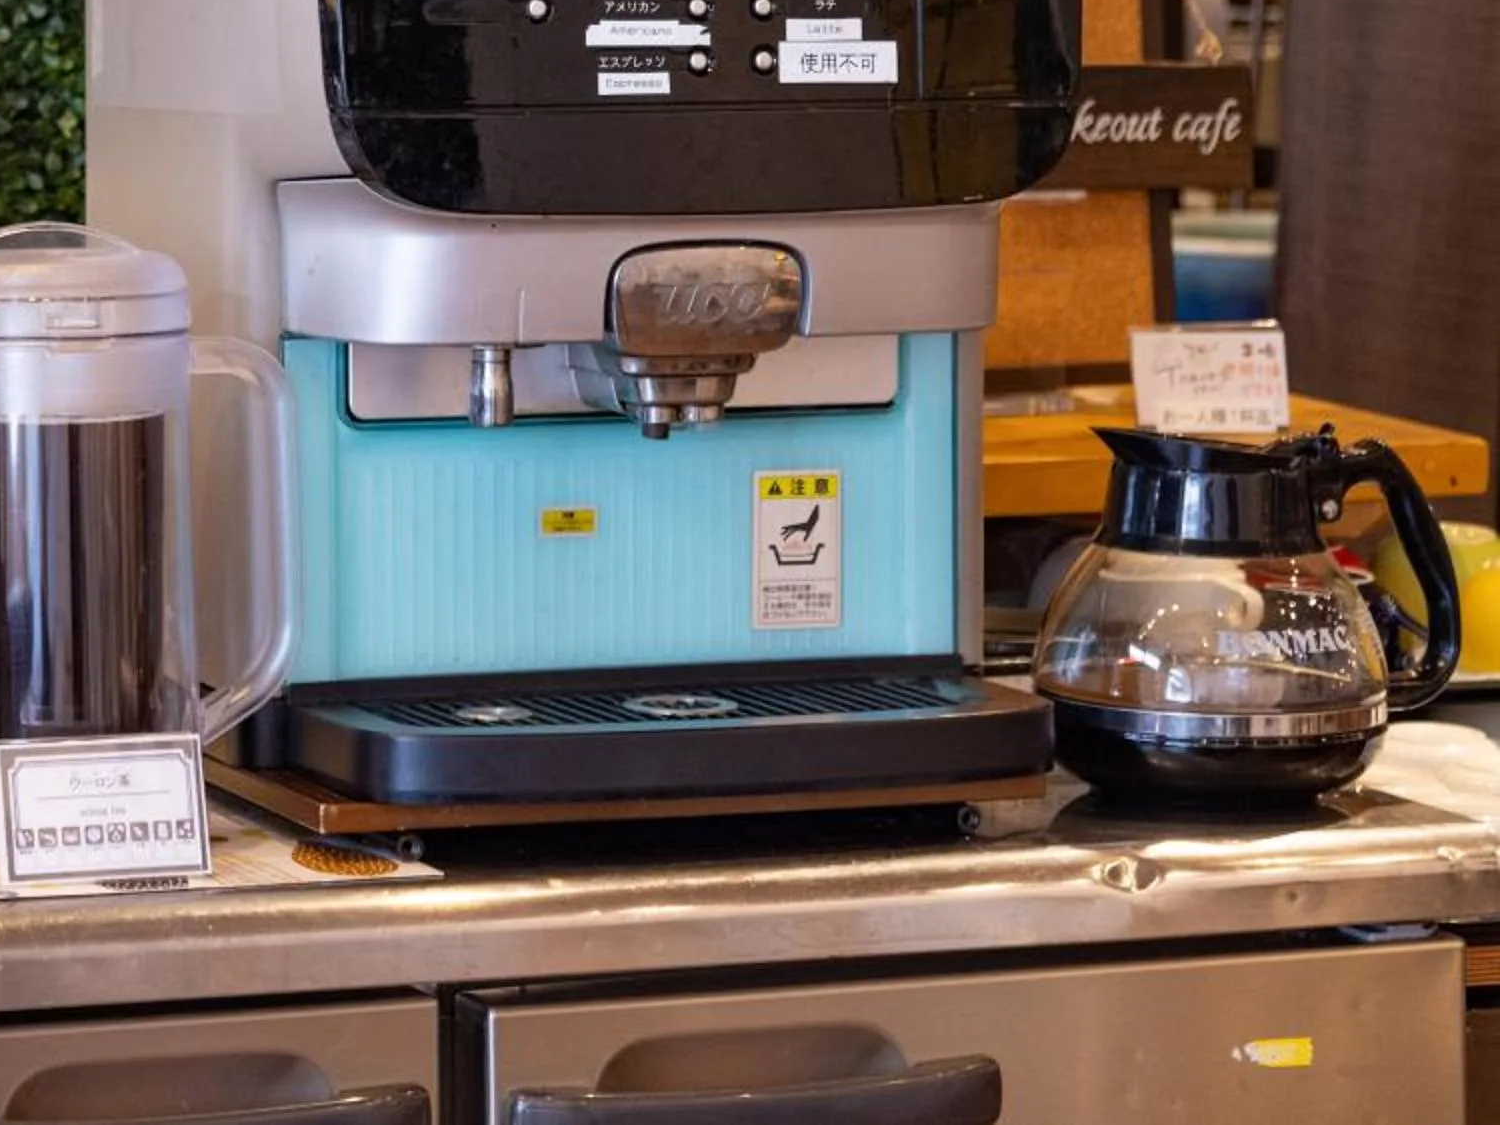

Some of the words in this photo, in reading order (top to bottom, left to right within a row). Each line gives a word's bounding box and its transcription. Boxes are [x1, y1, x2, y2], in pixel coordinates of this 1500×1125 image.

[604, 1, 661, 13] アメリカン
[800, 52, 877, 74] 使用不可
[1070, 98, 1164, 144] keout
